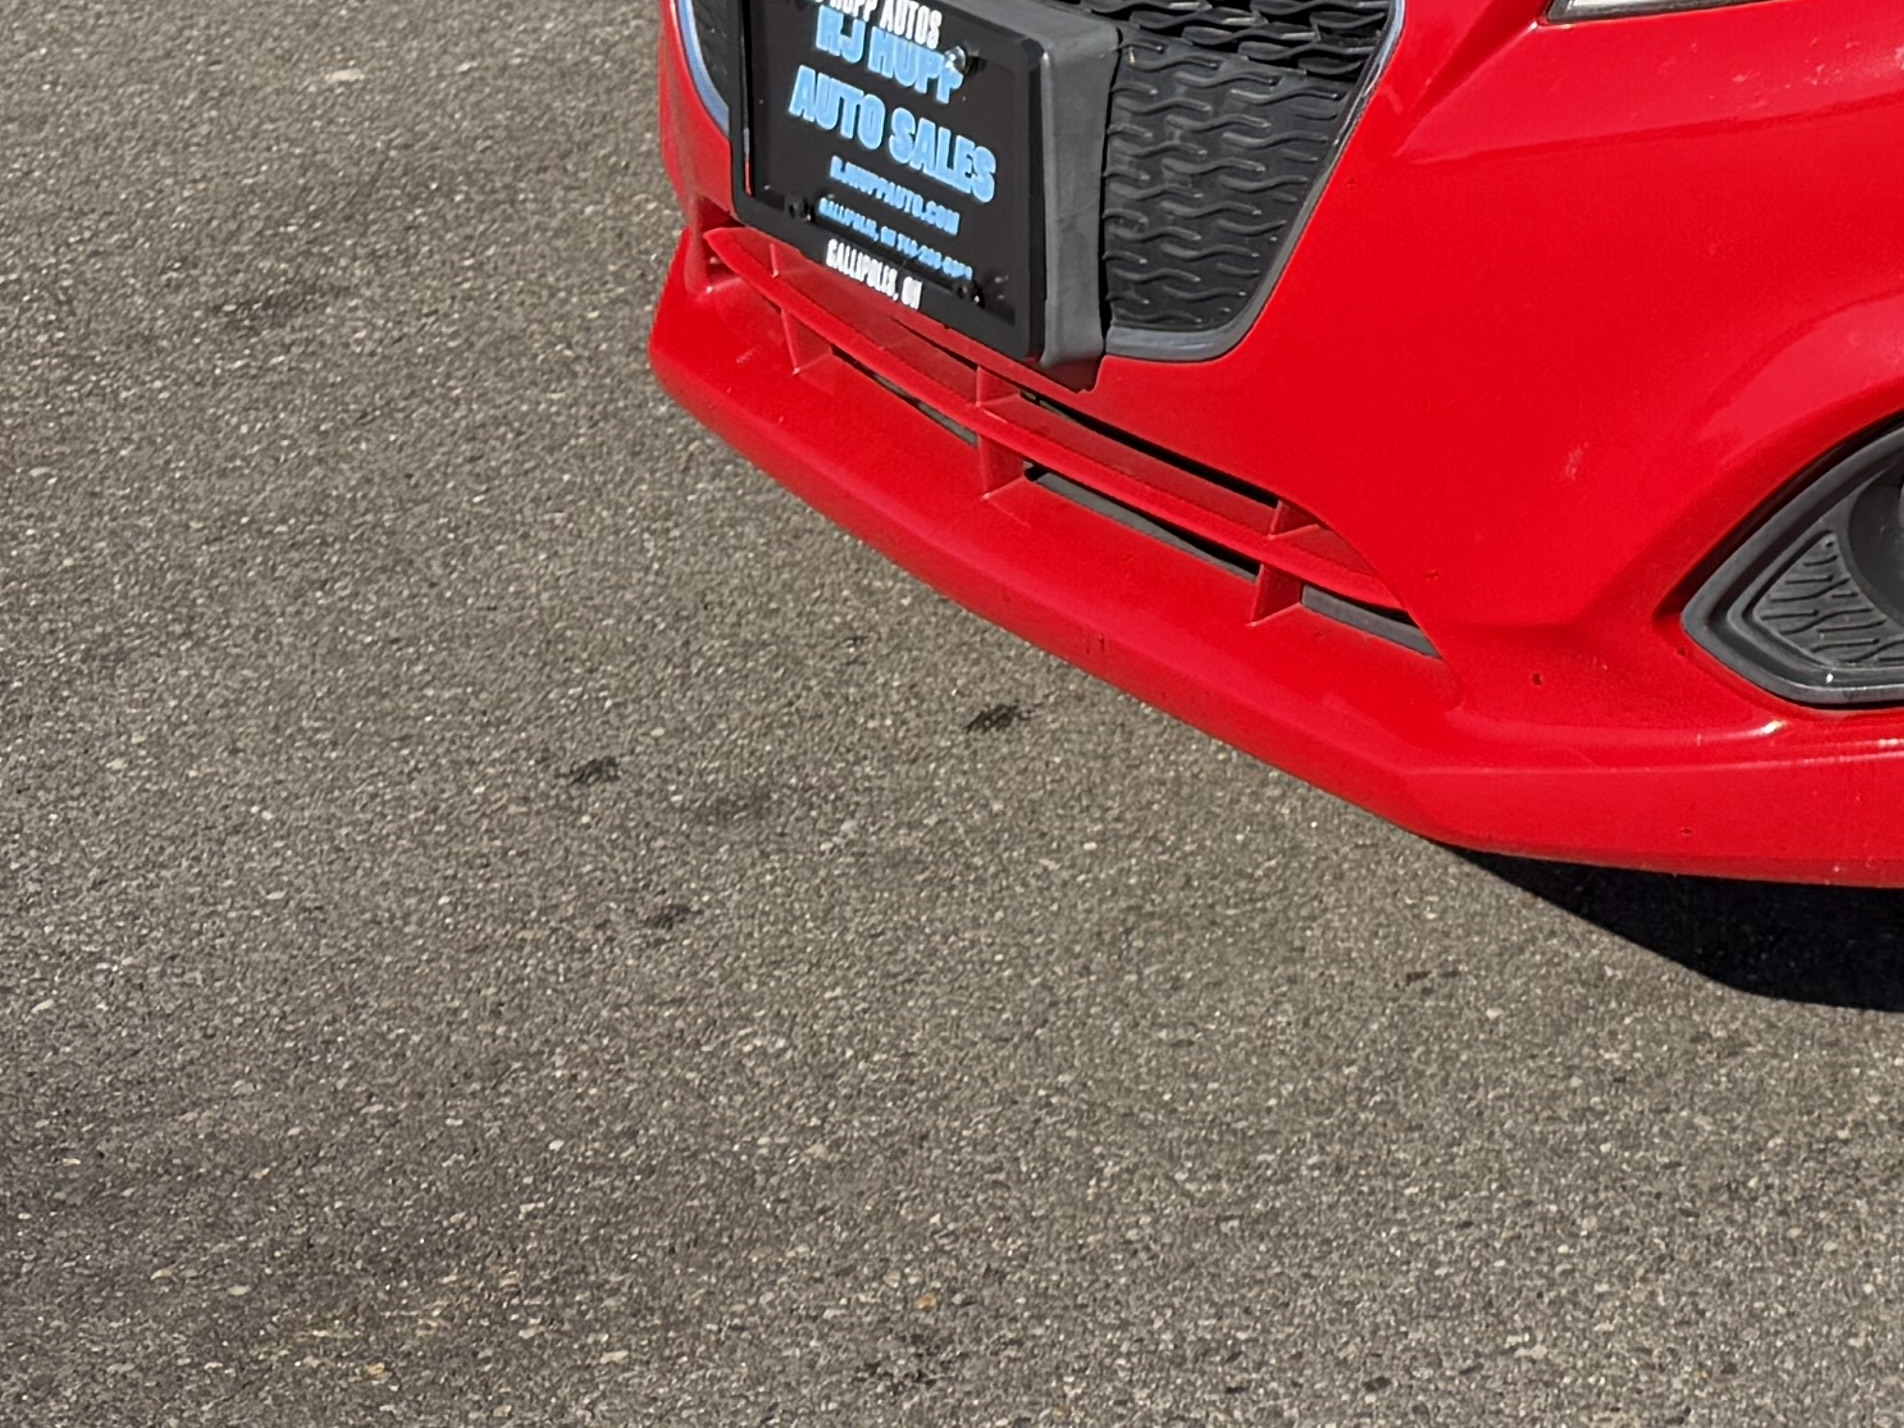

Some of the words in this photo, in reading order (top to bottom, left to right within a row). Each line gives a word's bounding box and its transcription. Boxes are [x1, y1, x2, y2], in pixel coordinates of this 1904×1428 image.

[816, 4, 867, 64] RJ
[867, 26, 964, 104] HUPP
[787, 64, 886, 150] AUTO
[888, 107, 996, 204] SALES
[900, 275, 924, 311] OH
